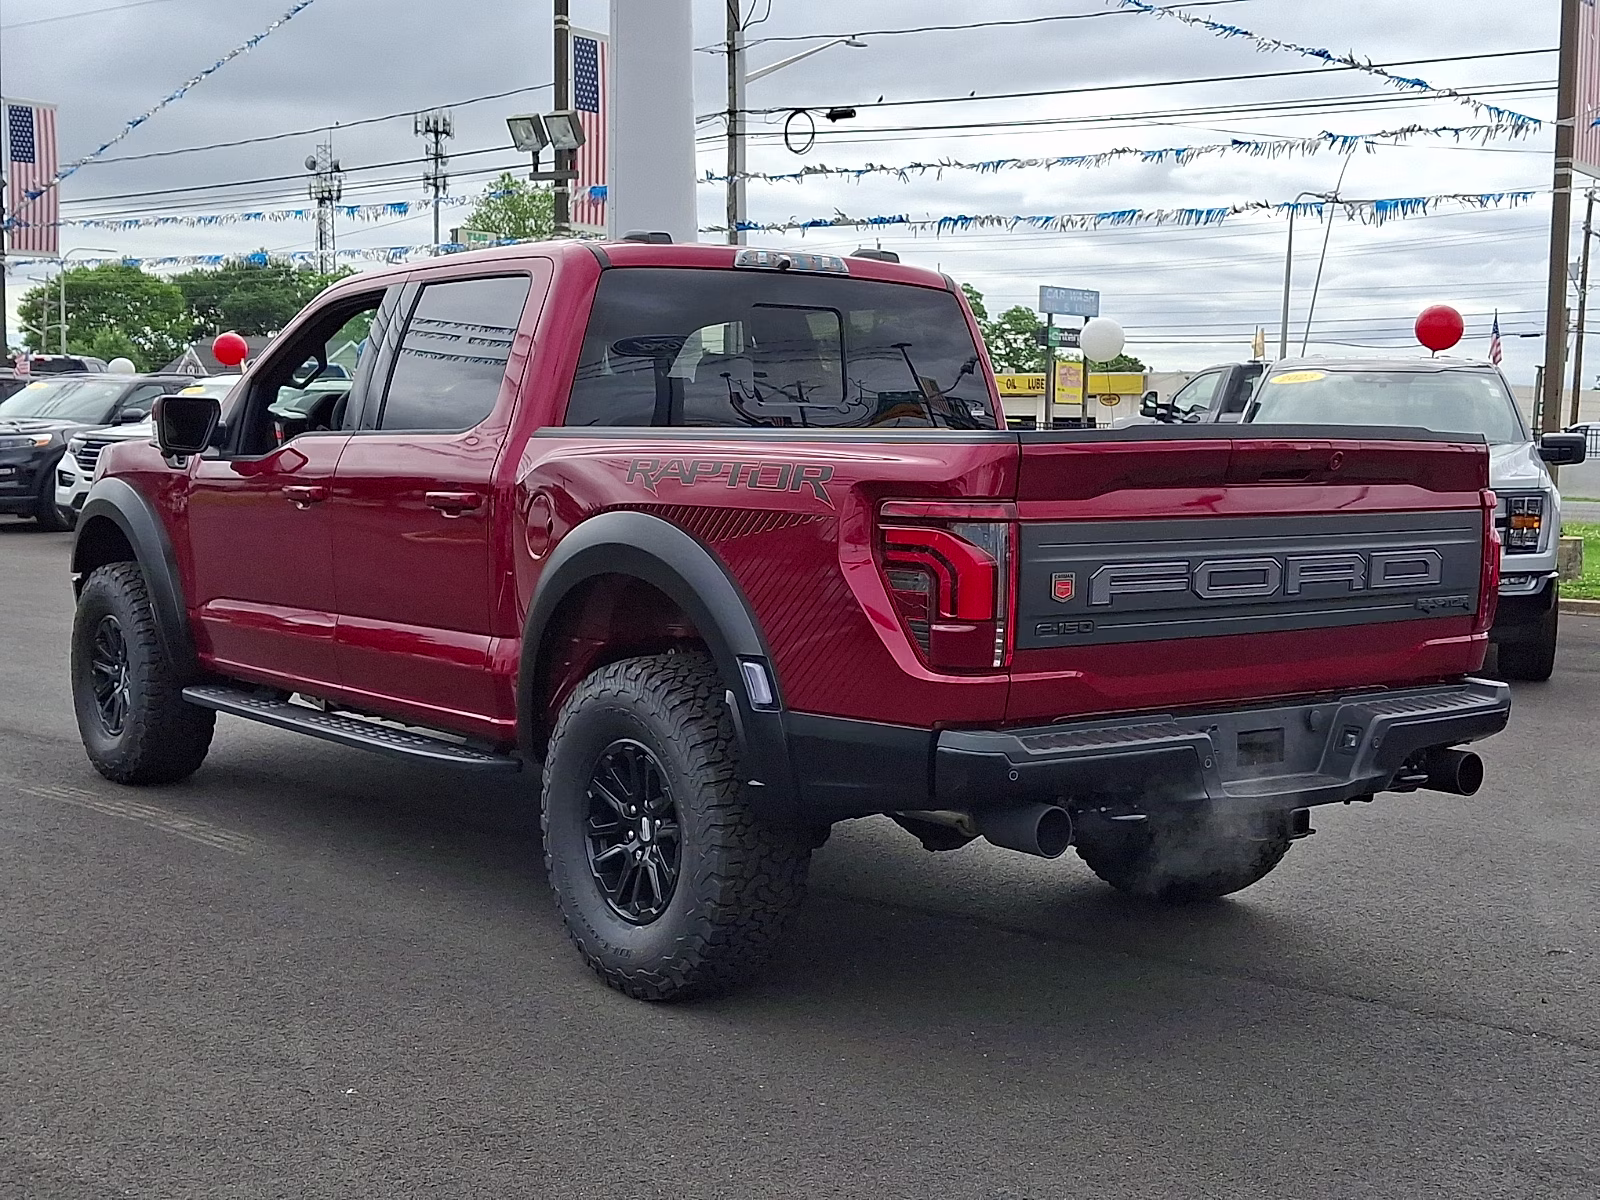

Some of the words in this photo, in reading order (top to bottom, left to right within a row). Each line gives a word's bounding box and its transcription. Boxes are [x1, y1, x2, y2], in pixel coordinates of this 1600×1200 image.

[1046, 288, 1065, 300] CAR
[1069, 290, 1095, 303] WASH
[1006, 378, 1017, 390] OIL
[1027, 378, 1045, 390] LUBE
[626, 459, 835, 510] RAPTOR
[1087, 549, 1442, 607] FORD
[1035, 620, 1094, 637] F-150
